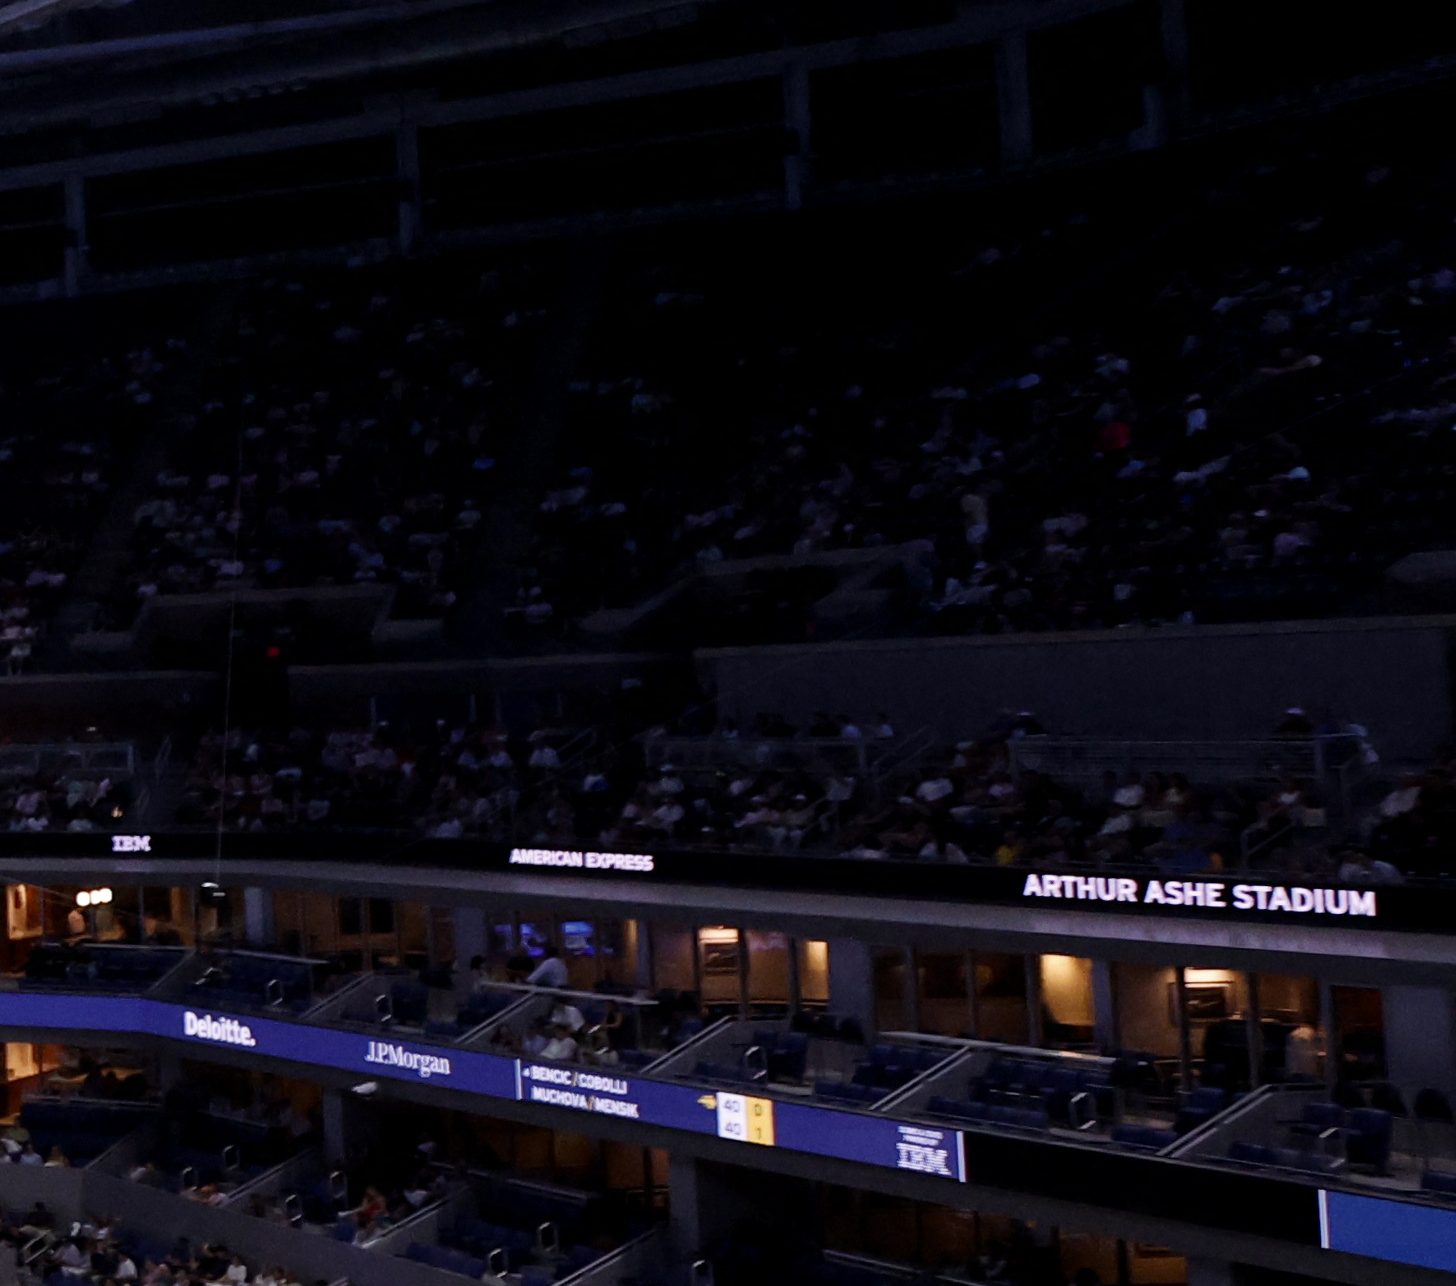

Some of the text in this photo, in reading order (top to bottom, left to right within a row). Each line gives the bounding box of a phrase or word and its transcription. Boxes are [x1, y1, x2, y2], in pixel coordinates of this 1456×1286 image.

[113, 836, 151, 851] IBM
[510, 849, 653, 871] AMERICAN EXPRESS
[1023, 874, 1375, 916] ARTHUR ASHE STADIUM
[185, 1012, 255, 1046] Deloitte.
[366, 1042, 450, 1077] J.P.Morgan
[724, 1099, 740, 1113] 40
[725, 1121, 742, 1136] 40
[756, 1127, 763, 1140] 1
